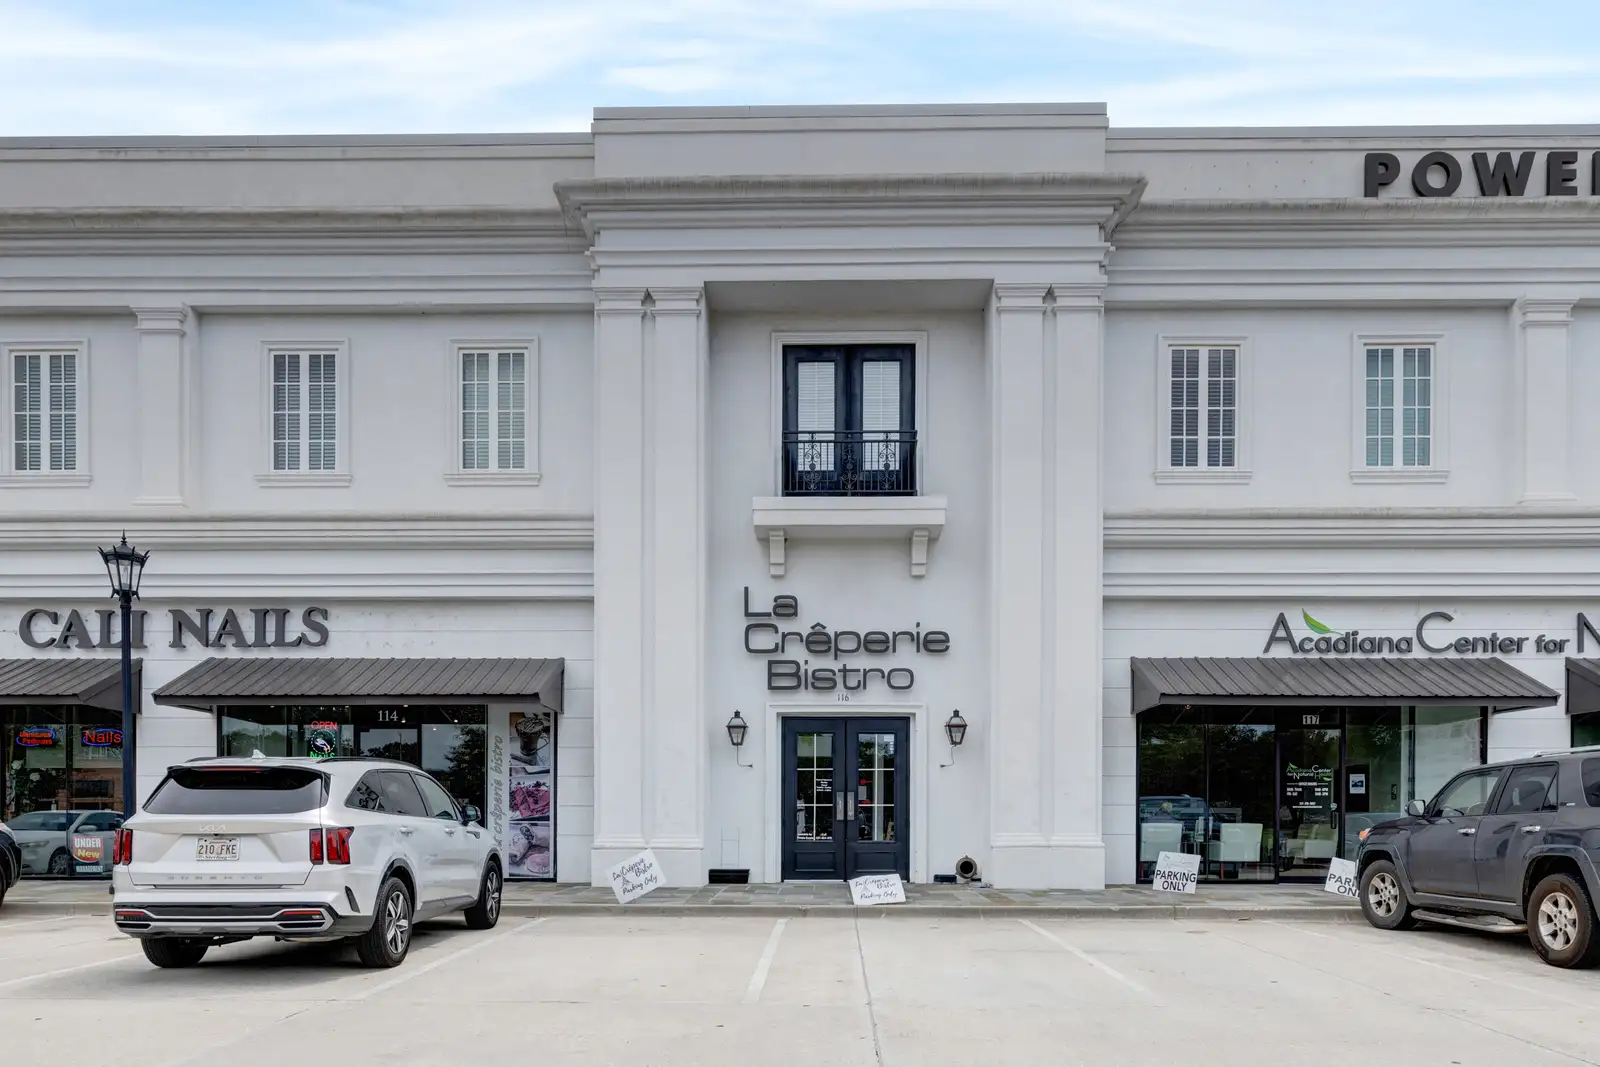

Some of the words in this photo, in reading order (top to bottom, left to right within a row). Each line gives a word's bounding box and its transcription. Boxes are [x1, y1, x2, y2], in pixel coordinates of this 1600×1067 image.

[1364, 151, 1600, 198] POWE
[743, 586, 799, 618] La
[18, 608, 148, 649] CALI
[168, 606, 329, 649] NAILS
[1262, 612, 1414, 654] Acadiana
[1416, 611, 1530, 654] Center
[1534, 634, 1571, 654] for
[744, 622, 951, 661] Crêperie
[767, 659, 915, 691] Bistro
[837, 692, 850, 702] 116
[377, 709, 399, 722] 114
[1303, 715, 1320, 724] 117
[311, 721, 338, 730] OPEN
[84, 730, 122, 743] Nails
[490, 735, 503, 775] bistro
[74, 837, 101, 848] UNDER
[77, 849, 100, 859] New
[198, 844, 215, 855] 210
[220, 844, 237, 855] FKE
[644, 873, 658, 886] Only
[1155, 869, 1197, 883] PARKING
[1328, 873, 1355, 888] PAR
[1162, 880, 1188, 892] ONLY
